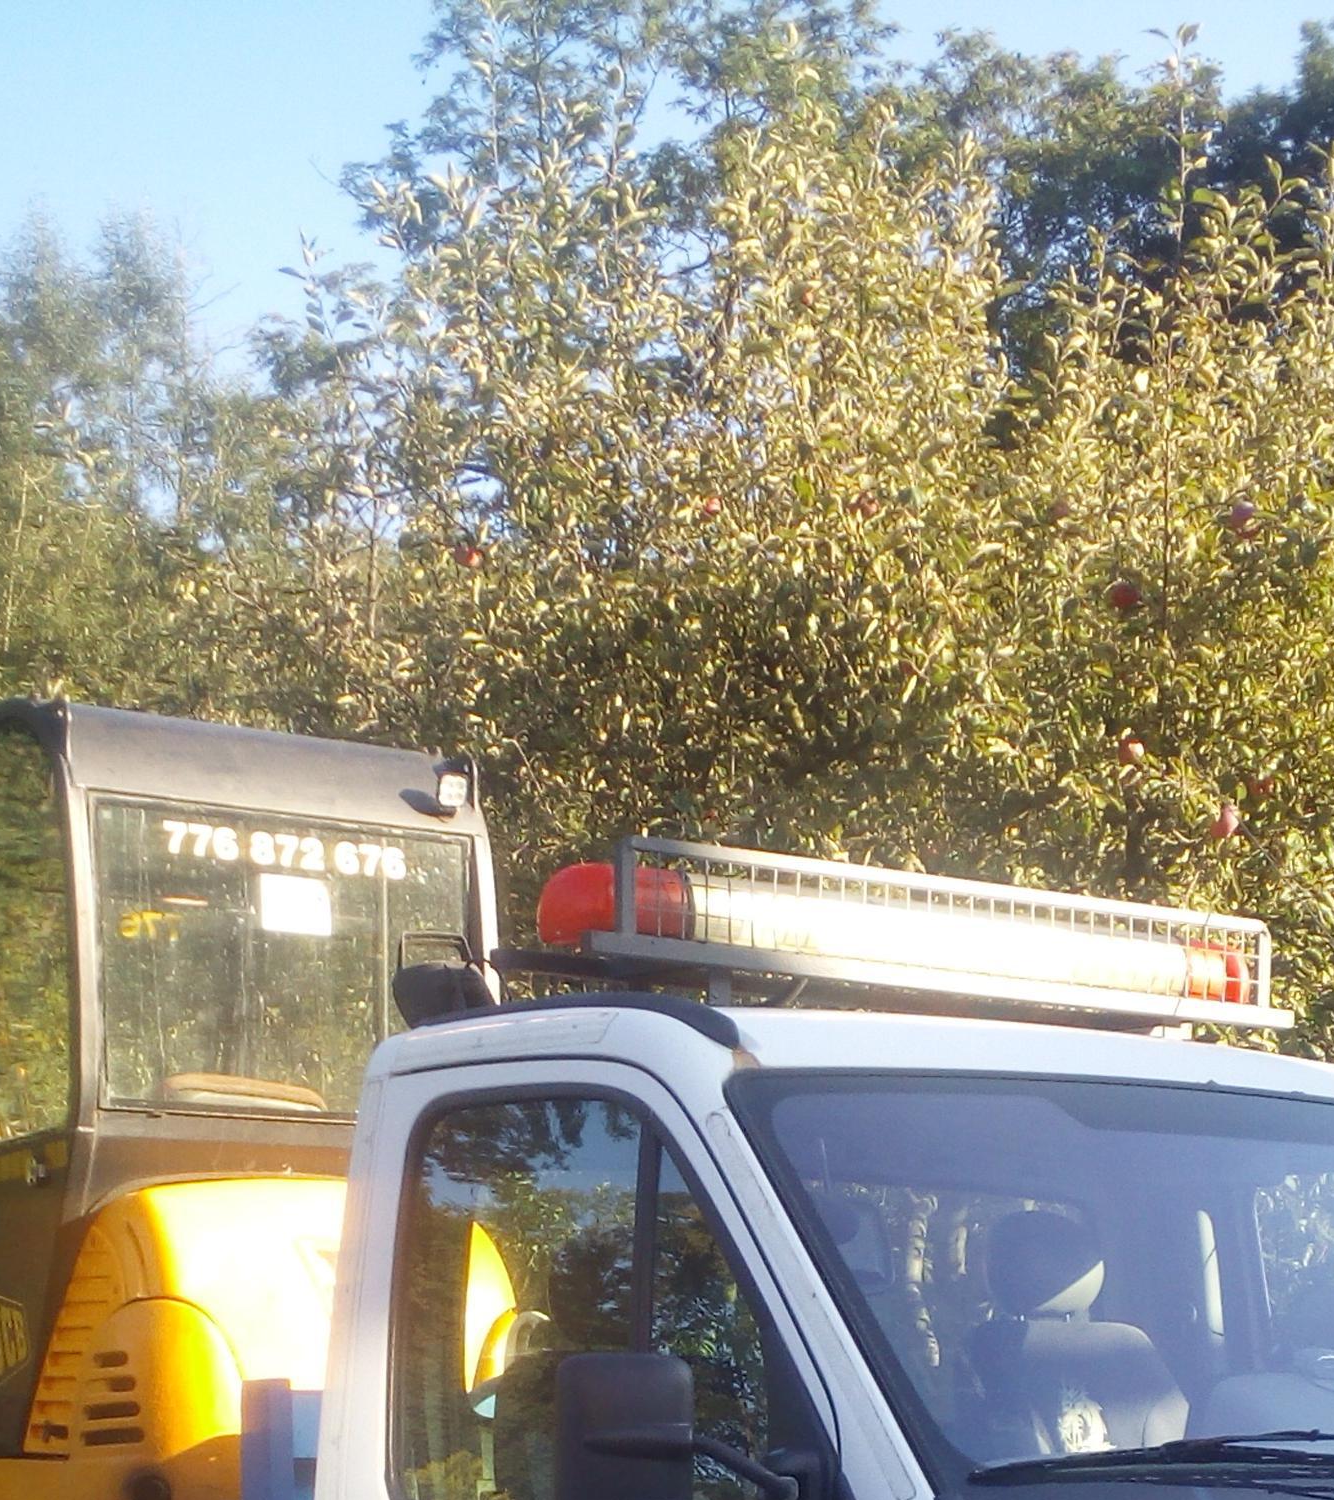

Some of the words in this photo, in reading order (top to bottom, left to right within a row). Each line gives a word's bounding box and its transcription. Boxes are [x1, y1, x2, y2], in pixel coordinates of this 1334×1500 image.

[162, 819, 239, 861] 776
[250, 831, 326, 871] 872
[334, 841, 407, 880] 676
